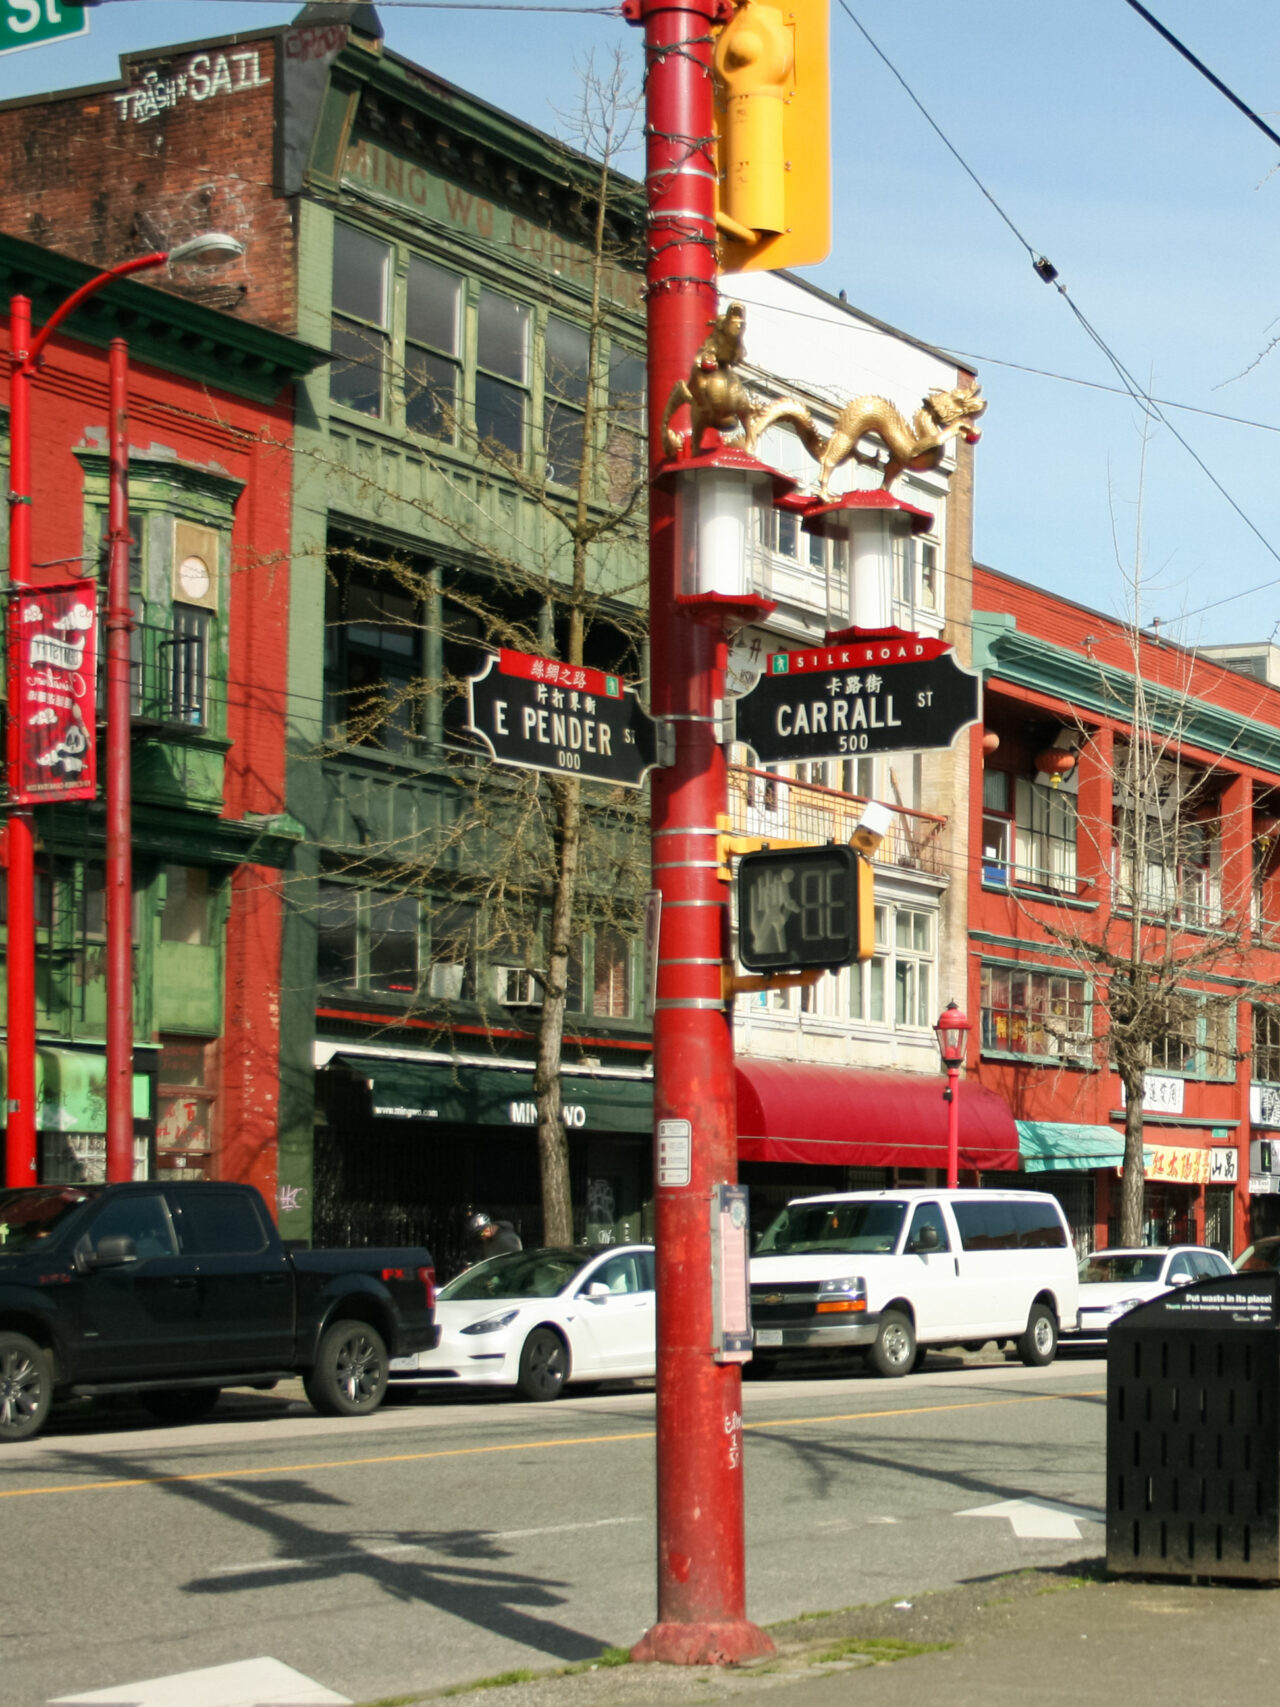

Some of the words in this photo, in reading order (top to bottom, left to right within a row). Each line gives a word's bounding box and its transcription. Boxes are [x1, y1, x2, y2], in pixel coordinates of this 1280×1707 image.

[797, 652, 850, 668] SILK
[866, 645, 924, 661] ROAD
[826, 673, 884, 697] 卡路街
[776, 695, 902, 736] CARRALL
[917, 691, 934, 708] ST
[495, 700, 509, 736] E
[522, 706, 612, 756] PENDER
[839, 734, 869, 752] 500
[559, 750, 581, 770] 000
[512, 1102, 538, 1123] MIN
[563, 1105, 586, 1126] WO
[1186, 1294, 1200, 1302] Put
[1201, 1295, 1225, 1303] waste
[1226, 1294, 1234, 1302] in
[1235, 1294, 1246, 1303] its
[1247, 1295, 1272, 1304] place!
